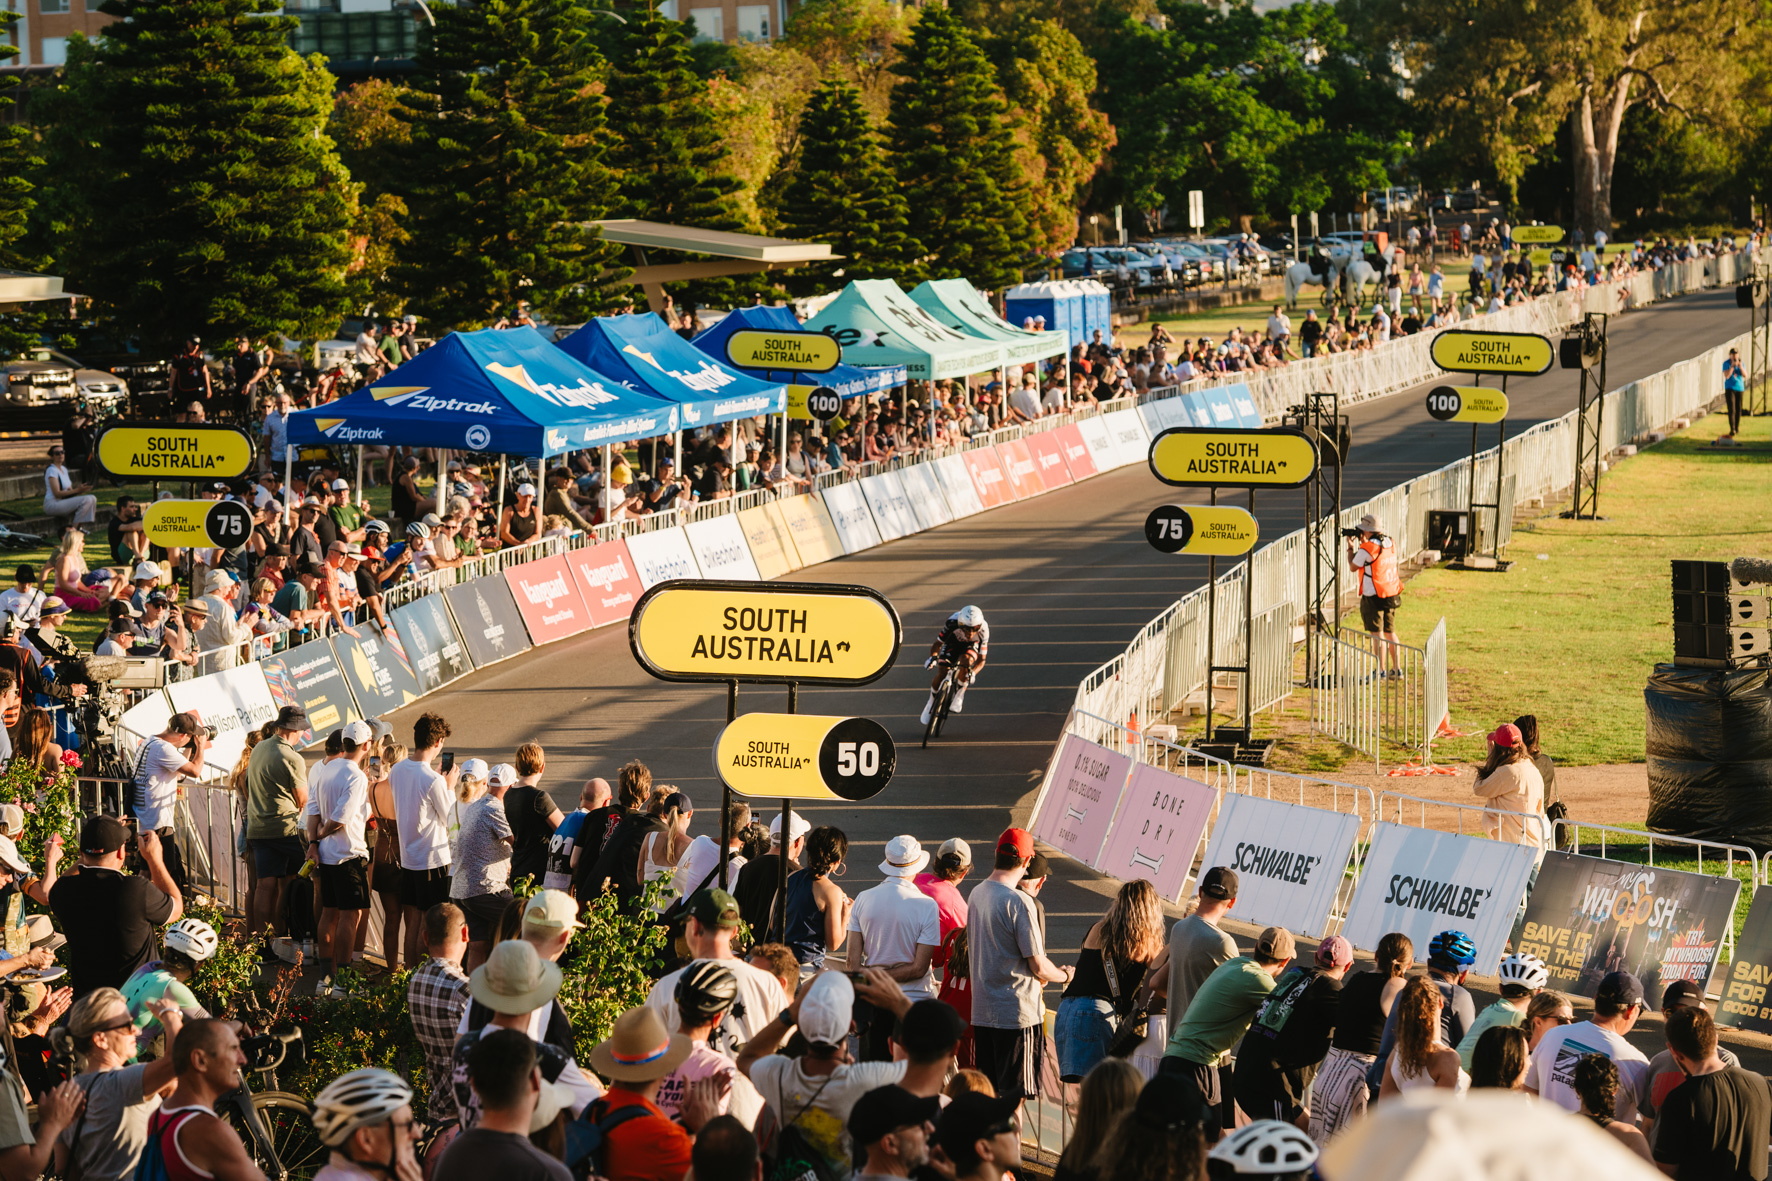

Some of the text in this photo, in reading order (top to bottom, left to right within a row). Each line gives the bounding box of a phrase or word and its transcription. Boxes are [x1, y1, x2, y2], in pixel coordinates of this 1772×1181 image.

[764, 339, 801, 351] SOUTH
[1471, 341, 1511, 352] SOUTH
[751, 351, 813, 363] AUSTRALIA
[1457, 352, 1523, 365] AUSTRALIA
[407, 395, 495, 414] Ziptrak
[810, 395, 838, 412] 100
[1428, 395, 1458, 411] 100
[337, 427, 383, 441] Ziptrak
[147, 437, 198, 452] SOUTH
[1205, 442, 1259, 457] SOUTH
[130, 453, 215, 468] AUSTRALIA
[1187, 459, 1277, 475] AUSTRALIA
[152, 524, 196, 532] AUSTRALIA
[161, 516, 187, 524] SOUTH
[217, 515, 242, 535] 75
[1209, 523, 1237, 531] SOUTH
[1156, 518, 1183, 540] 75
[1200, 531, 1245, 540] AUSTRALIA
[580, 555, 629, 592] Vanguard
[519, 571, 570, 608] Vanguard
[723, 606, 807, 633] SOUTH
[691, 635, 834, 663] AUSTRALIA
[204, 703, 275, 733] Wilson Parking
[748, 741, 789, 754] SOUTH
[732, 755, 802, 769] AUSTRALIA
[837, 742, 880, 777] 50
[1089, 759, 1110, 782] SUGAR
[1078, 783, 1101, 802] DELICIOUS
[1153, 791, 1185, 816] BONE
[1058, 828, 1078, 844] BONE DRY
[1141, 819, 1175, 844] DRY
[1230, 842, 1315, 885] SCHWALBE
[1384, 874, 1485, 920] SCHWALBE
[1582, 884, 1678, 929] WHOOSH
[1523, 922, 1592, 950] SAVE IT
[1685, 930, 1705, 946] TRY
[1517, 940, 1586, 968] FOR THE
[1663, 947, 1715, 963] MYWHOOSH
[1546, 965, 1580, 982] STUFF!
[1659, 964, 1707, 980] TODAY FOR
[1727, 981, 1767, 1004] FOR
[1722, 1000, 1759, 1017] GOOD
[1551, 1072, 1576, 1089] patag
